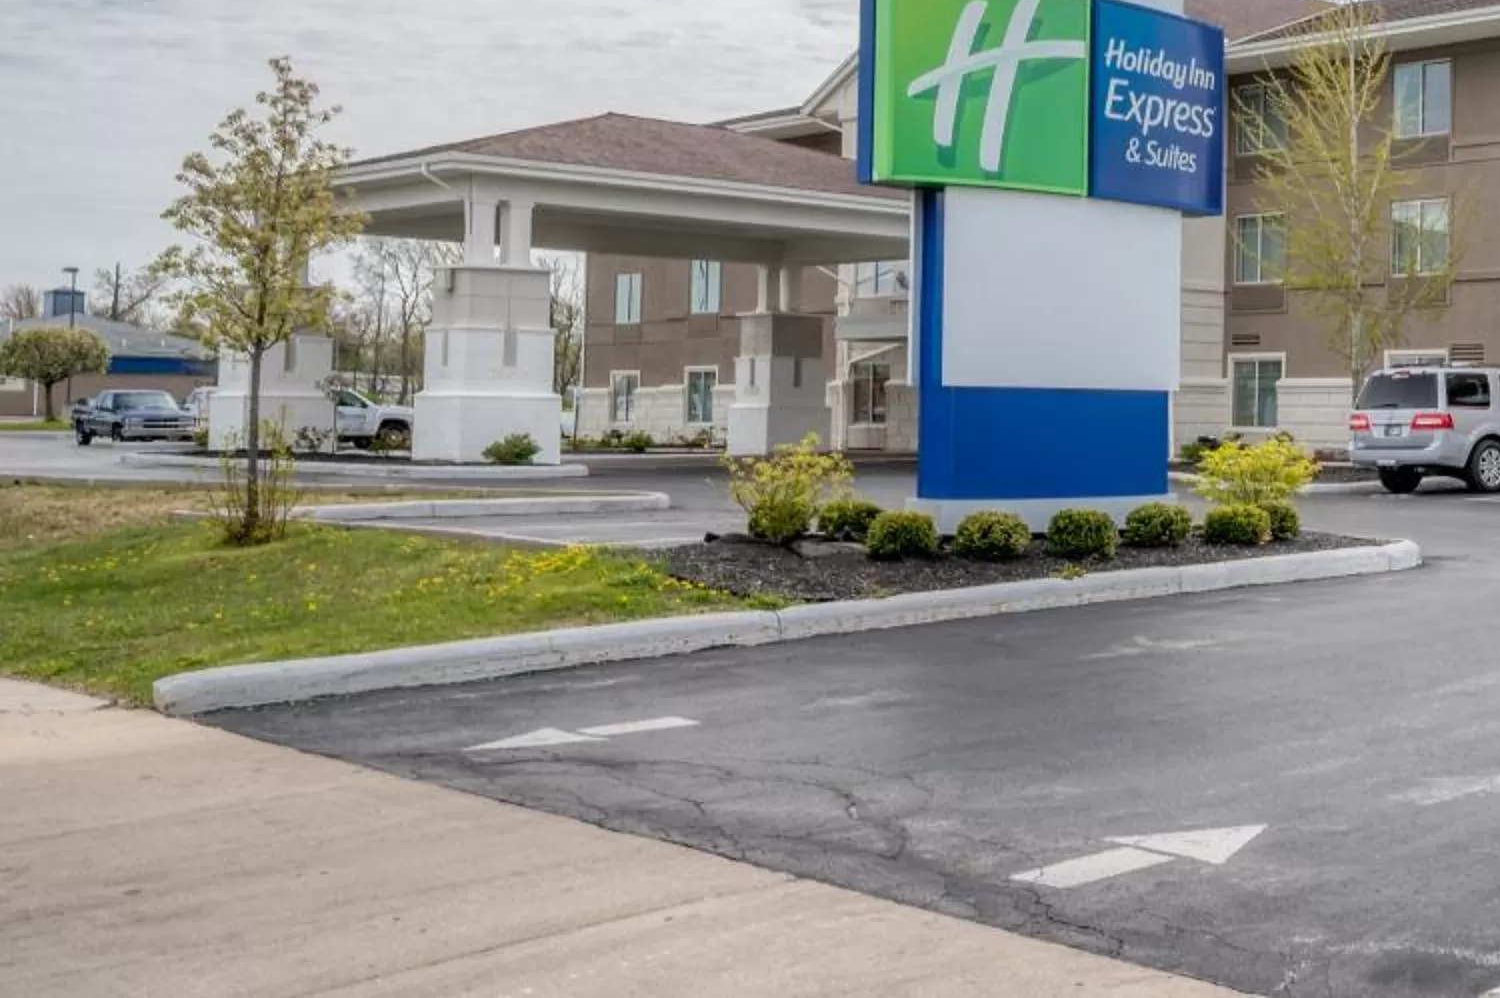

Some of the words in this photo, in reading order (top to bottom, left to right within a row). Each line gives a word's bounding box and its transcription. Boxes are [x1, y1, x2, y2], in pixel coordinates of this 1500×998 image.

[1104, 37, 1187, 90] Holiday
[1188, 57, 1216, 91] Inn
[1104, 77, 1214, 138] Express
[1125, 137, 1141, 163] &
[1144, 139, 1197, 173] Suites
